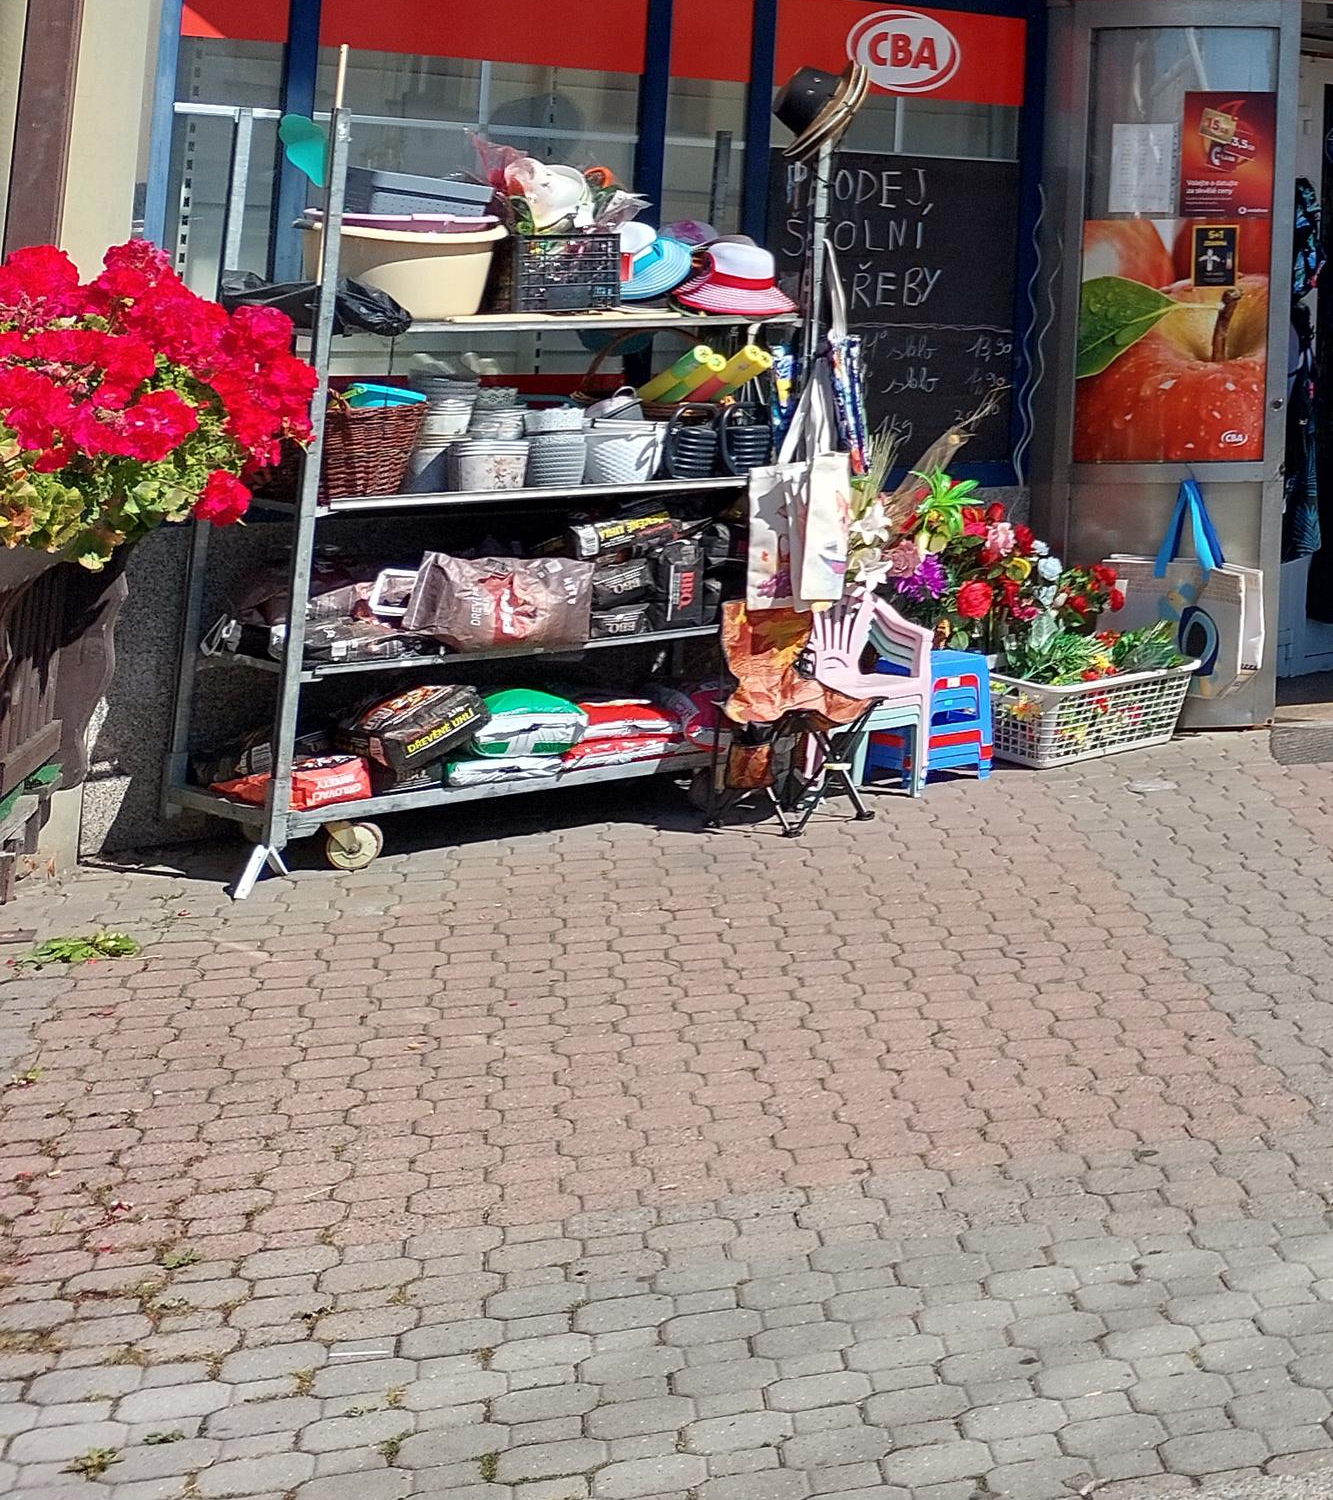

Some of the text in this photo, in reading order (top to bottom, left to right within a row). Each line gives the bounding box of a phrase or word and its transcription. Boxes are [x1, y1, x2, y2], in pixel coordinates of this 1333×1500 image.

[868, 31, 938, 71] CBA
[786, 163, 928, 208] PODEJ
[782, 202, 934, 257] ŠOLNÍ
[406, 720, 452, 754] DŘEVĚNÉ
[451, 707, 475, 728] UHLÍ
